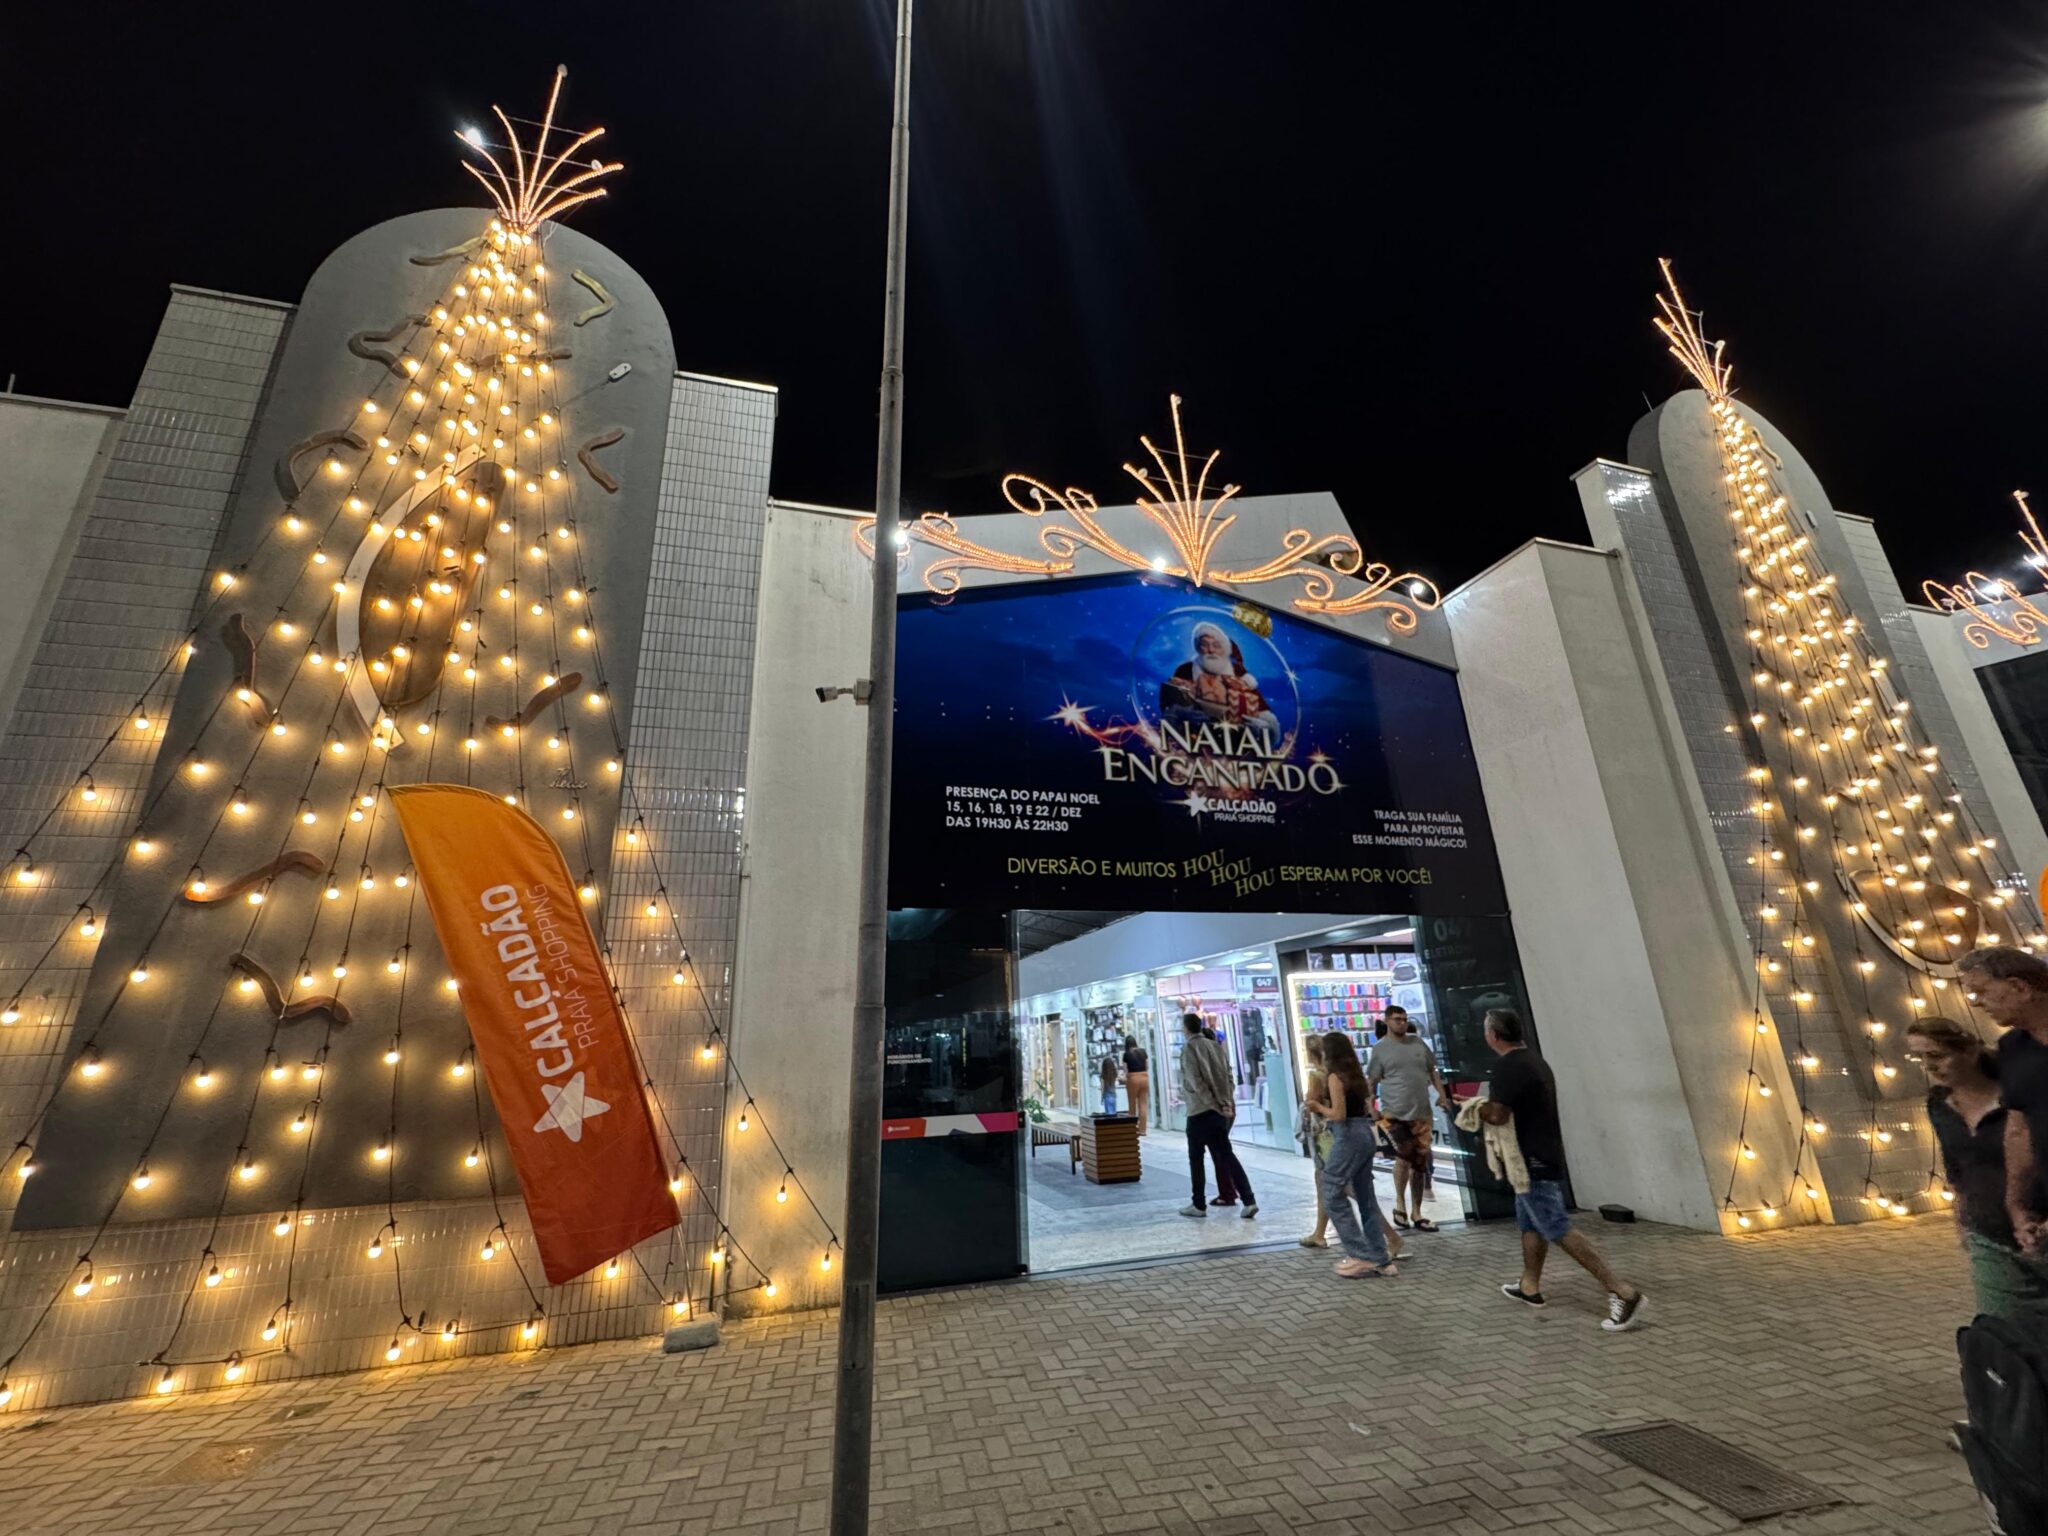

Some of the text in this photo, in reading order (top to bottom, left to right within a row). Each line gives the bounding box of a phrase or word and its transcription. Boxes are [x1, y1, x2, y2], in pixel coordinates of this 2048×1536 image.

[1159, 718, 1287, 759] NATAL
[1101, 747, 1341, 795] ENCANTADO
[946, 786, 1100, 804] PRESENÇA DO PAPAI NOEL
[946, 801, 1082, 818] 15, 16, 18, 19 E 22 / DEZ
[1207, 798, 1277, 814] CALÇADÃO
[946, 816, 1069, 832] DAS 19H30 ÀS 22H30
[1214, 812, 1275, 824] PRAIA SHOPPING
[1374, 809, 1462, 823] TRAGA SUA FAMÍLIA
[1384, 823, 1464, 836] PARA APROVEITAR
[1352, 834, 1468, 849] ESSE MOMENTO MÁGICO!
[1008, 848, 1433, 897] DIVERSÃO E MUITOS HOU HOU HOU ESPERAM POR VOCÊ!
[526, 883, 599, 1049] PRAIA SHOPPING
[480, 884, 573, 1077] CALÇADÃO
